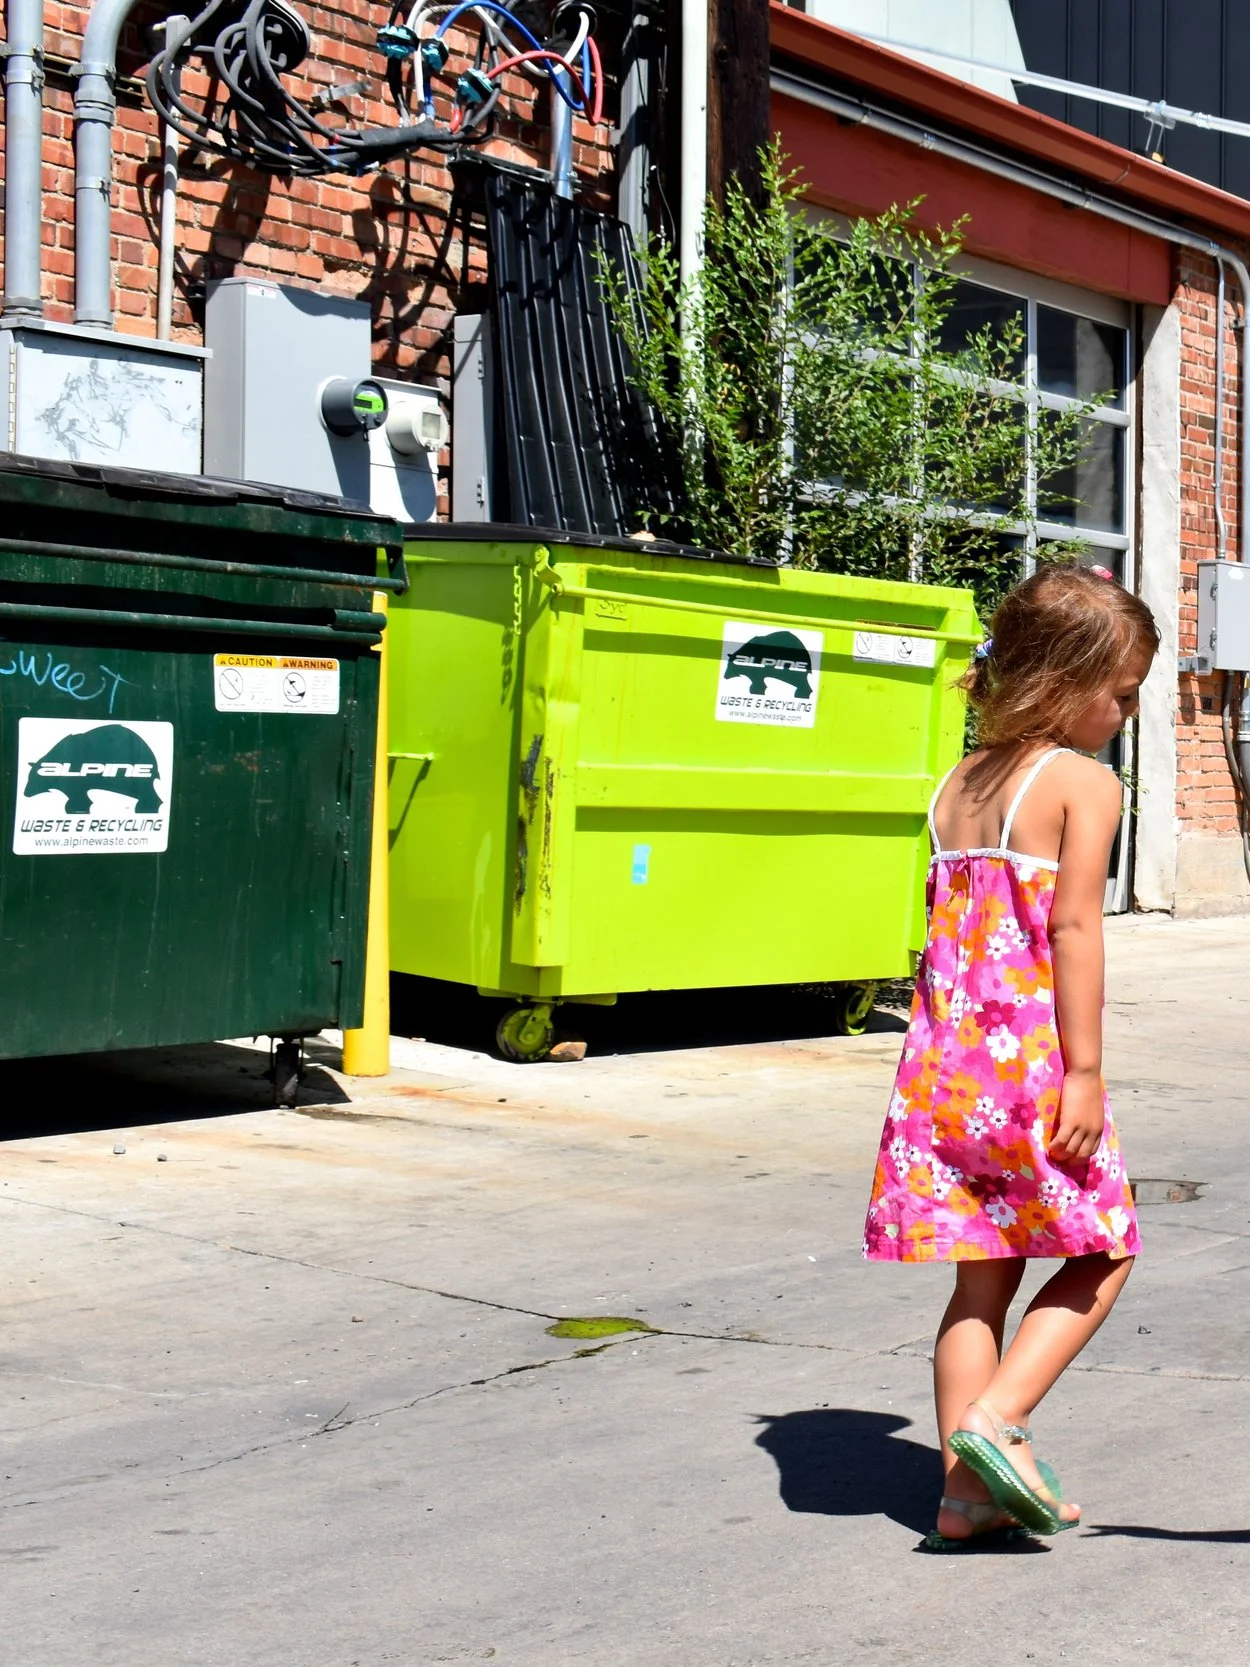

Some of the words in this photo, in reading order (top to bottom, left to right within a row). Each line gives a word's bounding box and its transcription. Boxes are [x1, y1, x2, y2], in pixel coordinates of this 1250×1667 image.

[228, 657, 273, 667] CAUTION
[289, 660, 333, 669] WARNING
[720, 696, 753, 708] WASTE
[763, 699, 812, 712] RECYCLING
[729, 711, 802, 721] www.alpinewaste.com
[37, 762, 153, 777] ALPINE
[20, 820, 72, 832] WASTE
[88, 819, 163, 832] RECYCLING
[34, 836, 149, 848] www.alpinewaste.com
